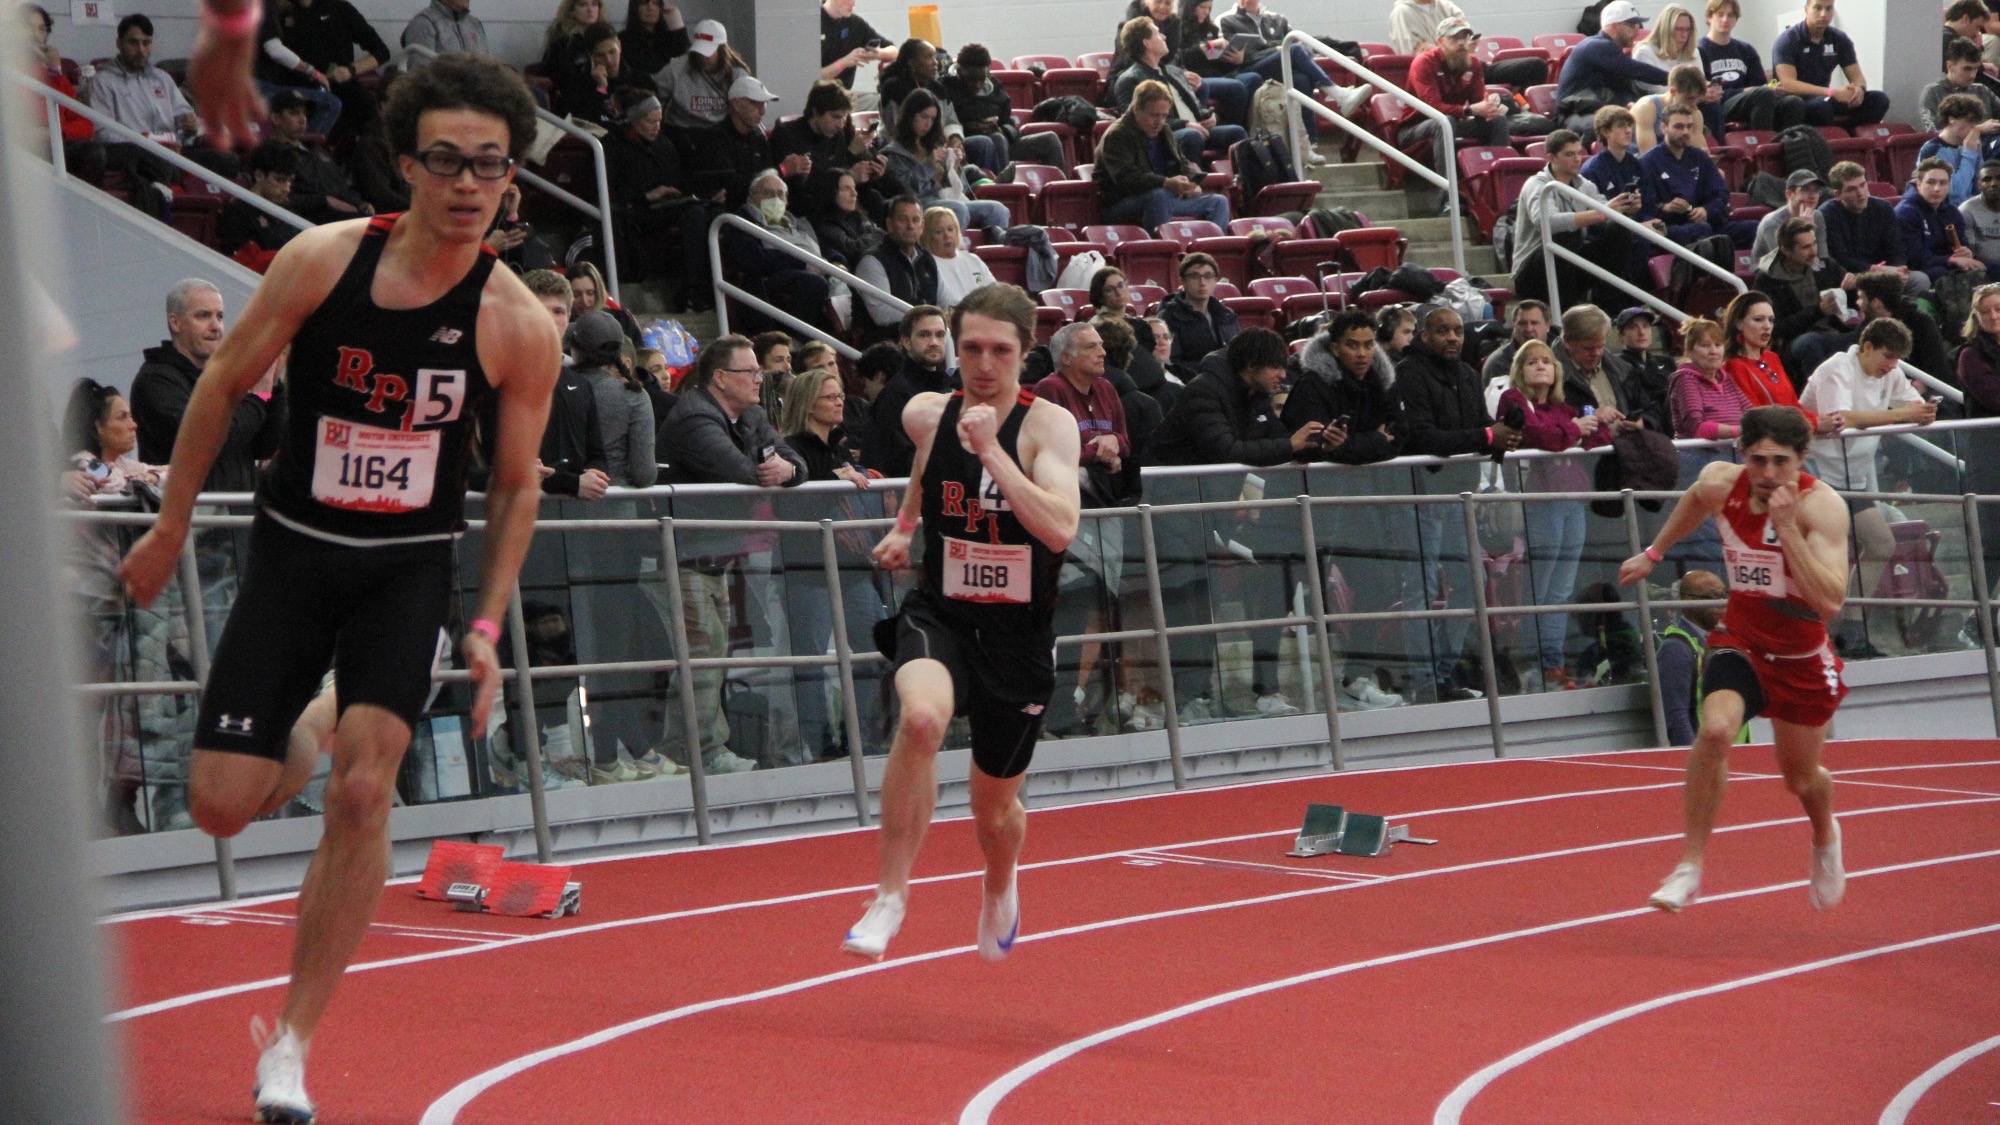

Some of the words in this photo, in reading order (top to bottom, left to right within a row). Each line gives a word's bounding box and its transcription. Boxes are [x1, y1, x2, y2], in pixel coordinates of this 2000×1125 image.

[424, 374, 455, 422] 5
[339, 452, 412, 490] 1164
[984, 479, 1005, 509] 4
[942, 481, 1002, 545] RPI
[962, 562, 1009, 588] 1168
[1733, 565, 1772, 586] 1646
